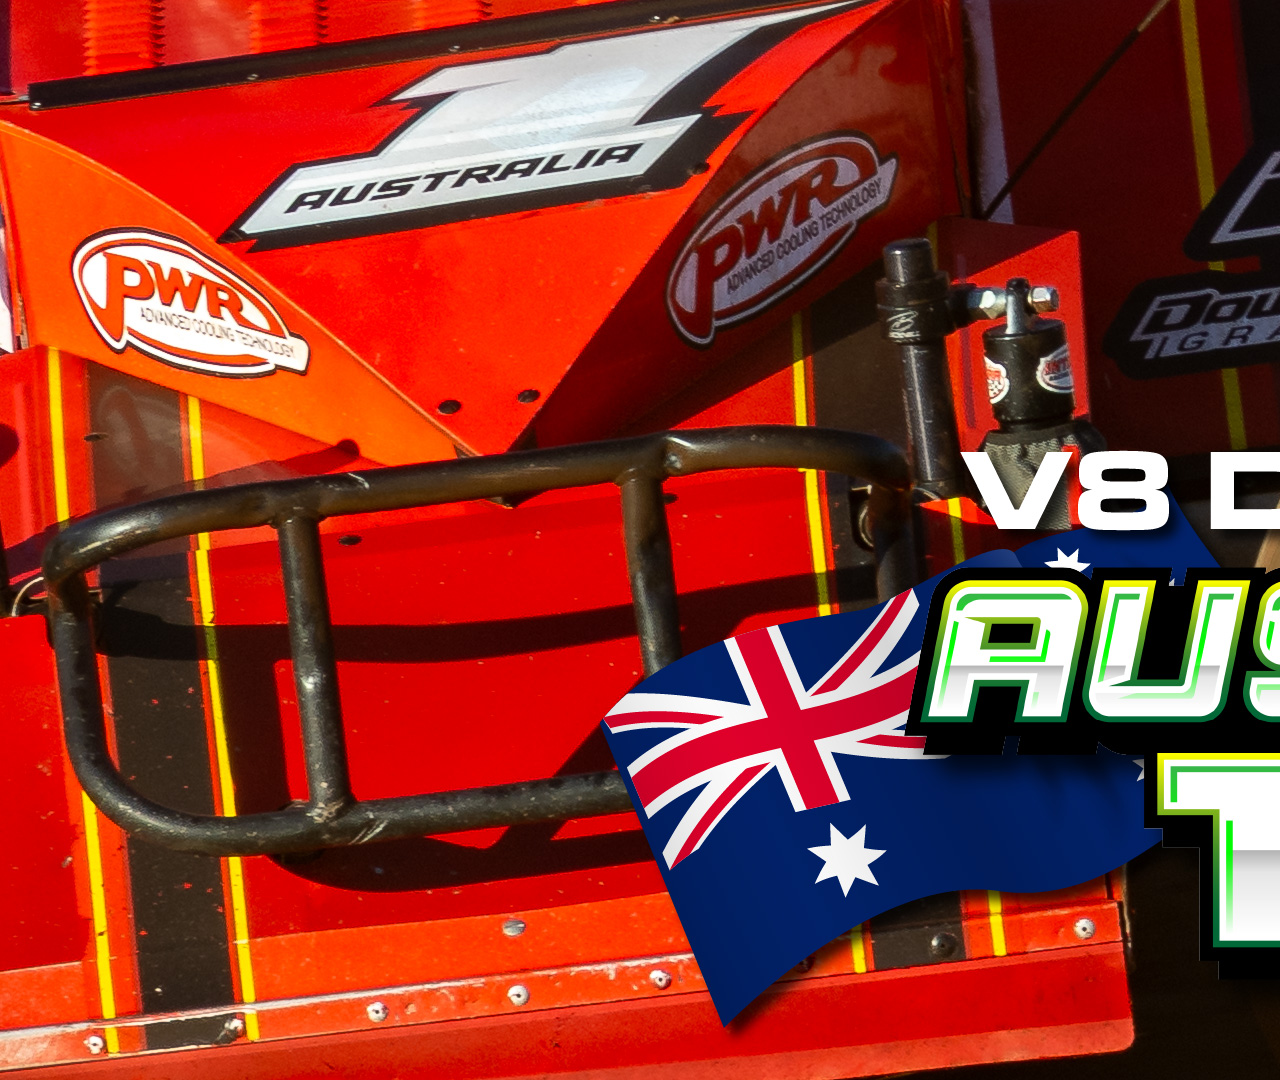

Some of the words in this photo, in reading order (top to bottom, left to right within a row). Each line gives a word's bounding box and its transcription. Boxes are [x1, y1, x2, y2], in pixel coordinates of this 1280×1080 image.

[286, 139, 644, 215] AUSTRALIA
[694, 159, 848, 320] PWR
[726, 248, 775, 295] ADVANCED
[775, 220, 820, 262] COOLING
[820, 177, 883, 232] TECHNOLOGY
[103, 250, 252, 341] PWR
[140, 307, 193, 332] ADVANCED
[193, 318, 236, 343] COOLING
[235, 329, 296, 360] TECHNOLOGY
